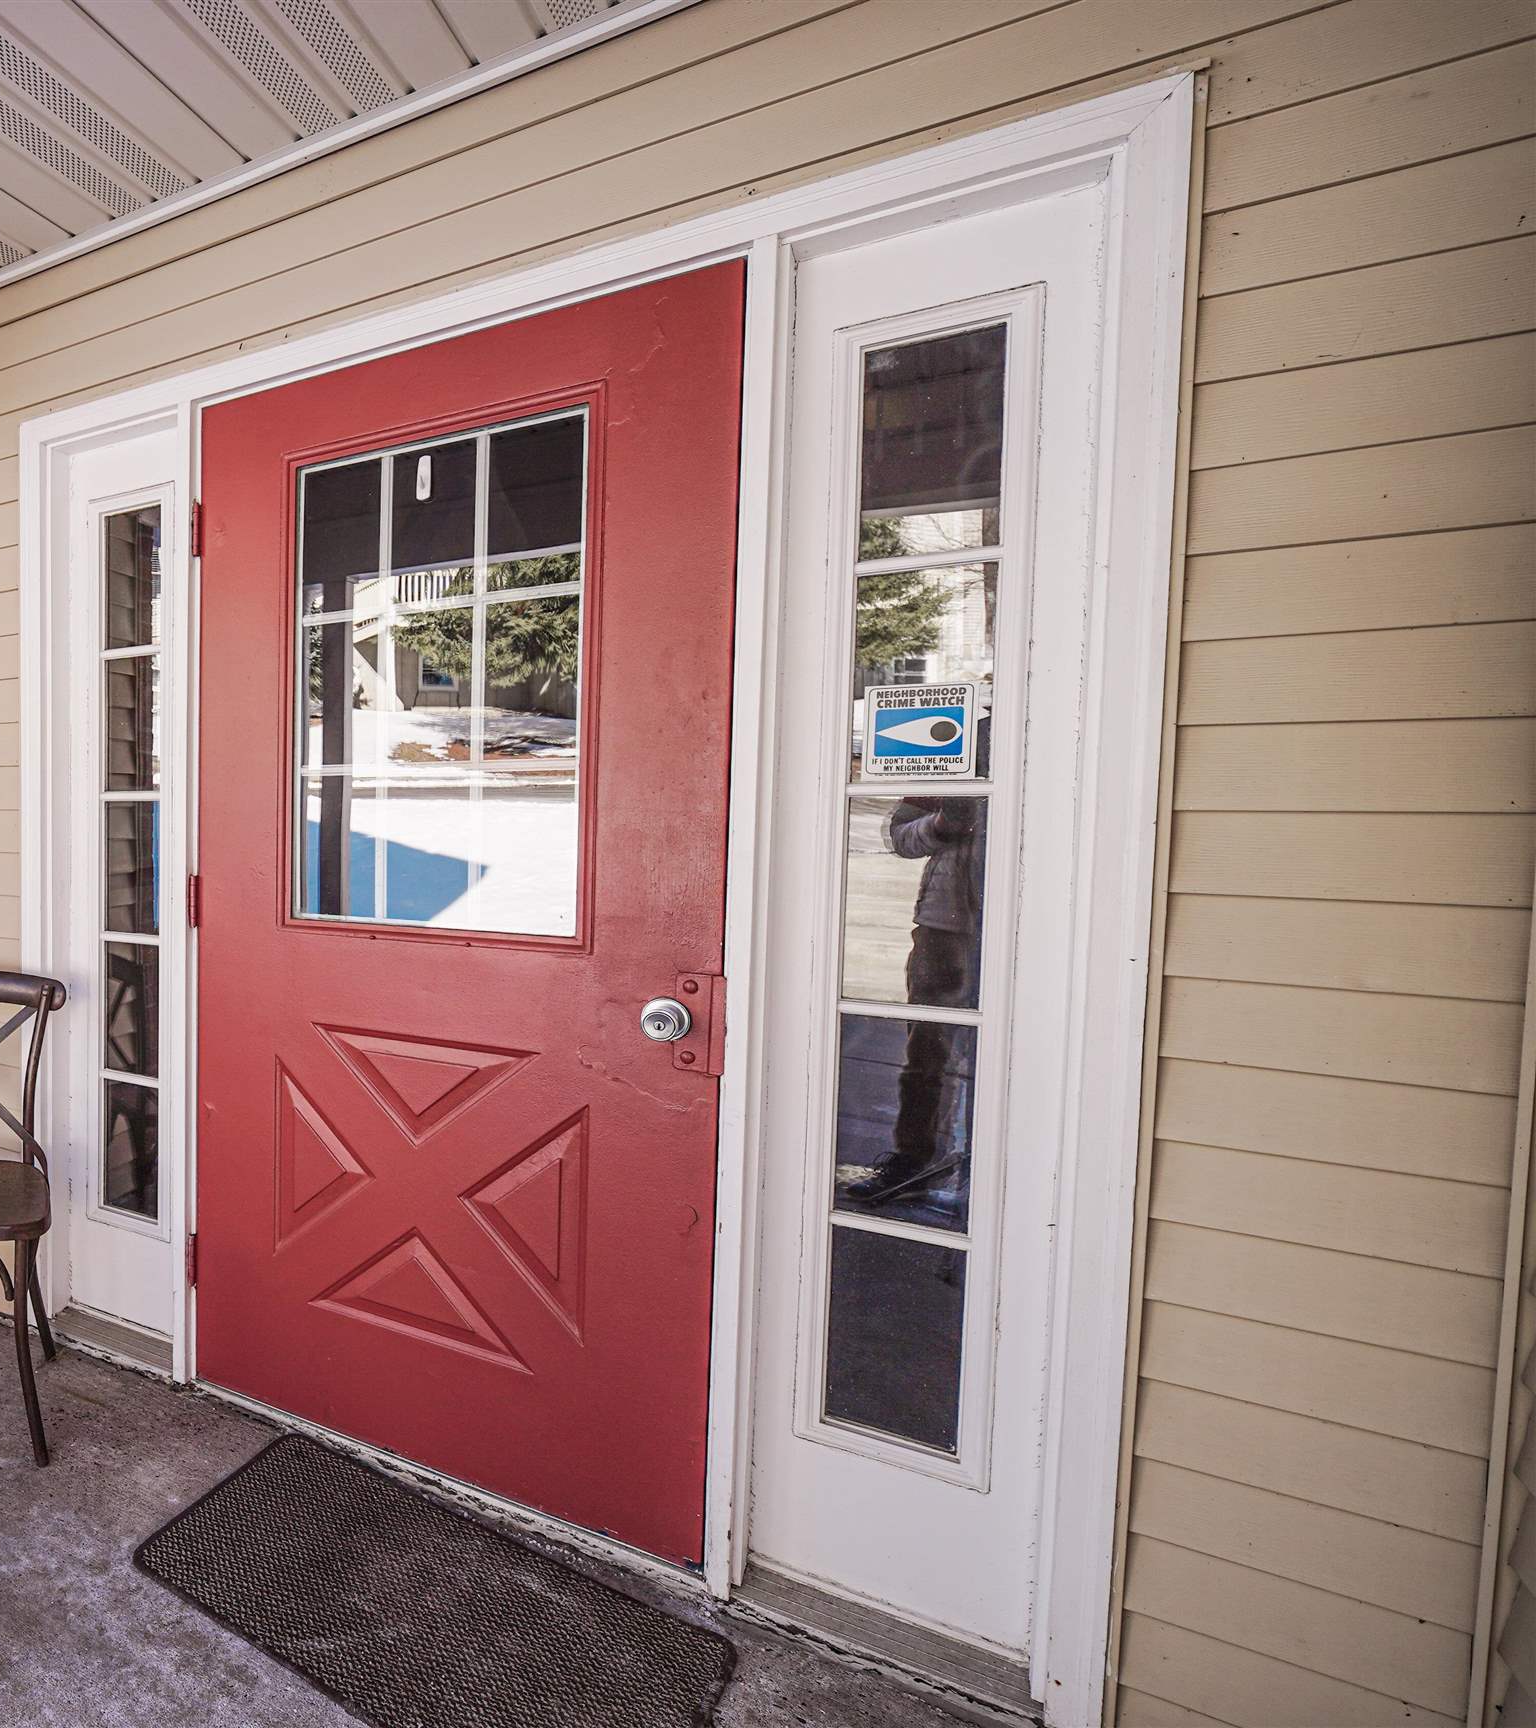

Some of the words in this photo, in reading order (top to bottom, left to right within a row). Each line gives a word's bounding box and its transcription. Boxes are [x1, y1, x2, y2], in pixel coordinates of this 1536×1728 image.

[876, 687, 967, 699] NEIGHBORHOOD
[877, 698, 916, 708] CRIME
[920, 696, 965, 707] WATCH
[939, 756, 964, 764] POLICE
